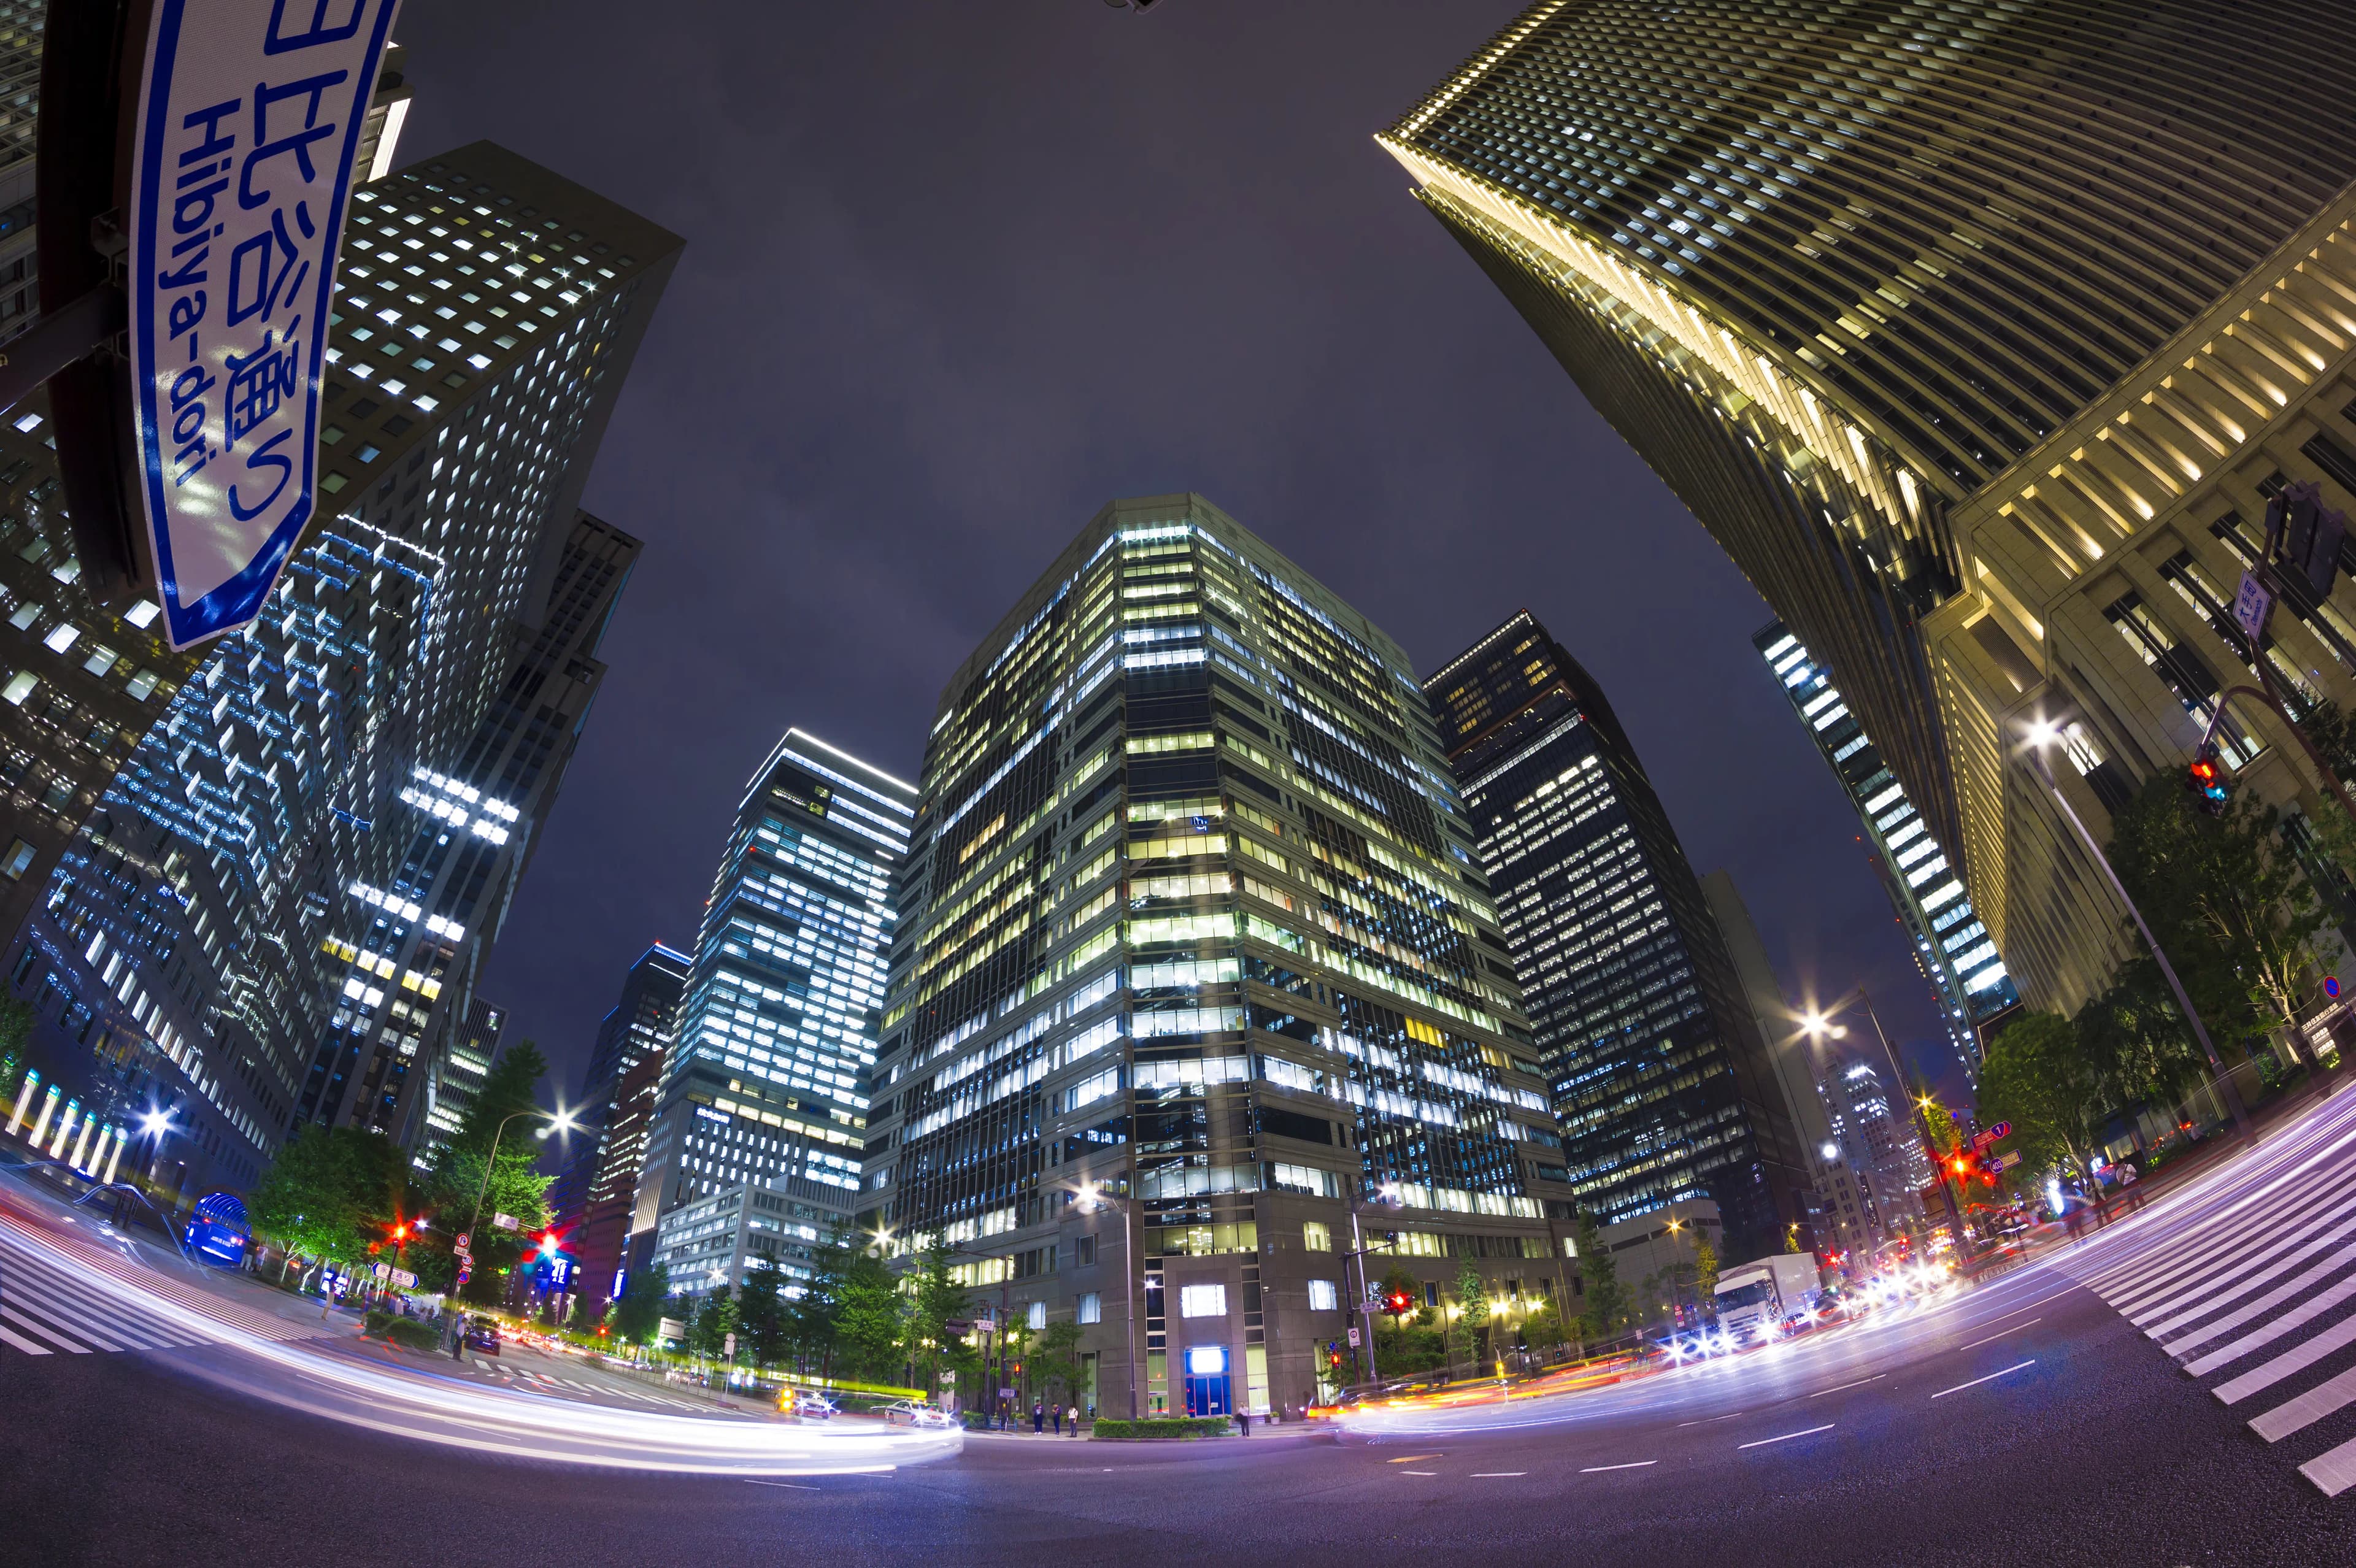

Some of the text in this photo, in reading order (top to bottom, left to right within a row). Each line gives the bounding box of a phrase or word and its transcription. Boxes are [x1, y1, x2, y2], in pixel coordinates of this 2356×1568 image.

[225, 0, 366, 521] 日比谷通り
[159, 98, 242, 490] Hibiya-dori
[2239, 580, 2256, 624] 大手町
[1995, 1126, 2001, 1134] 1
[1992, 1161, 2003, 1170] 403
